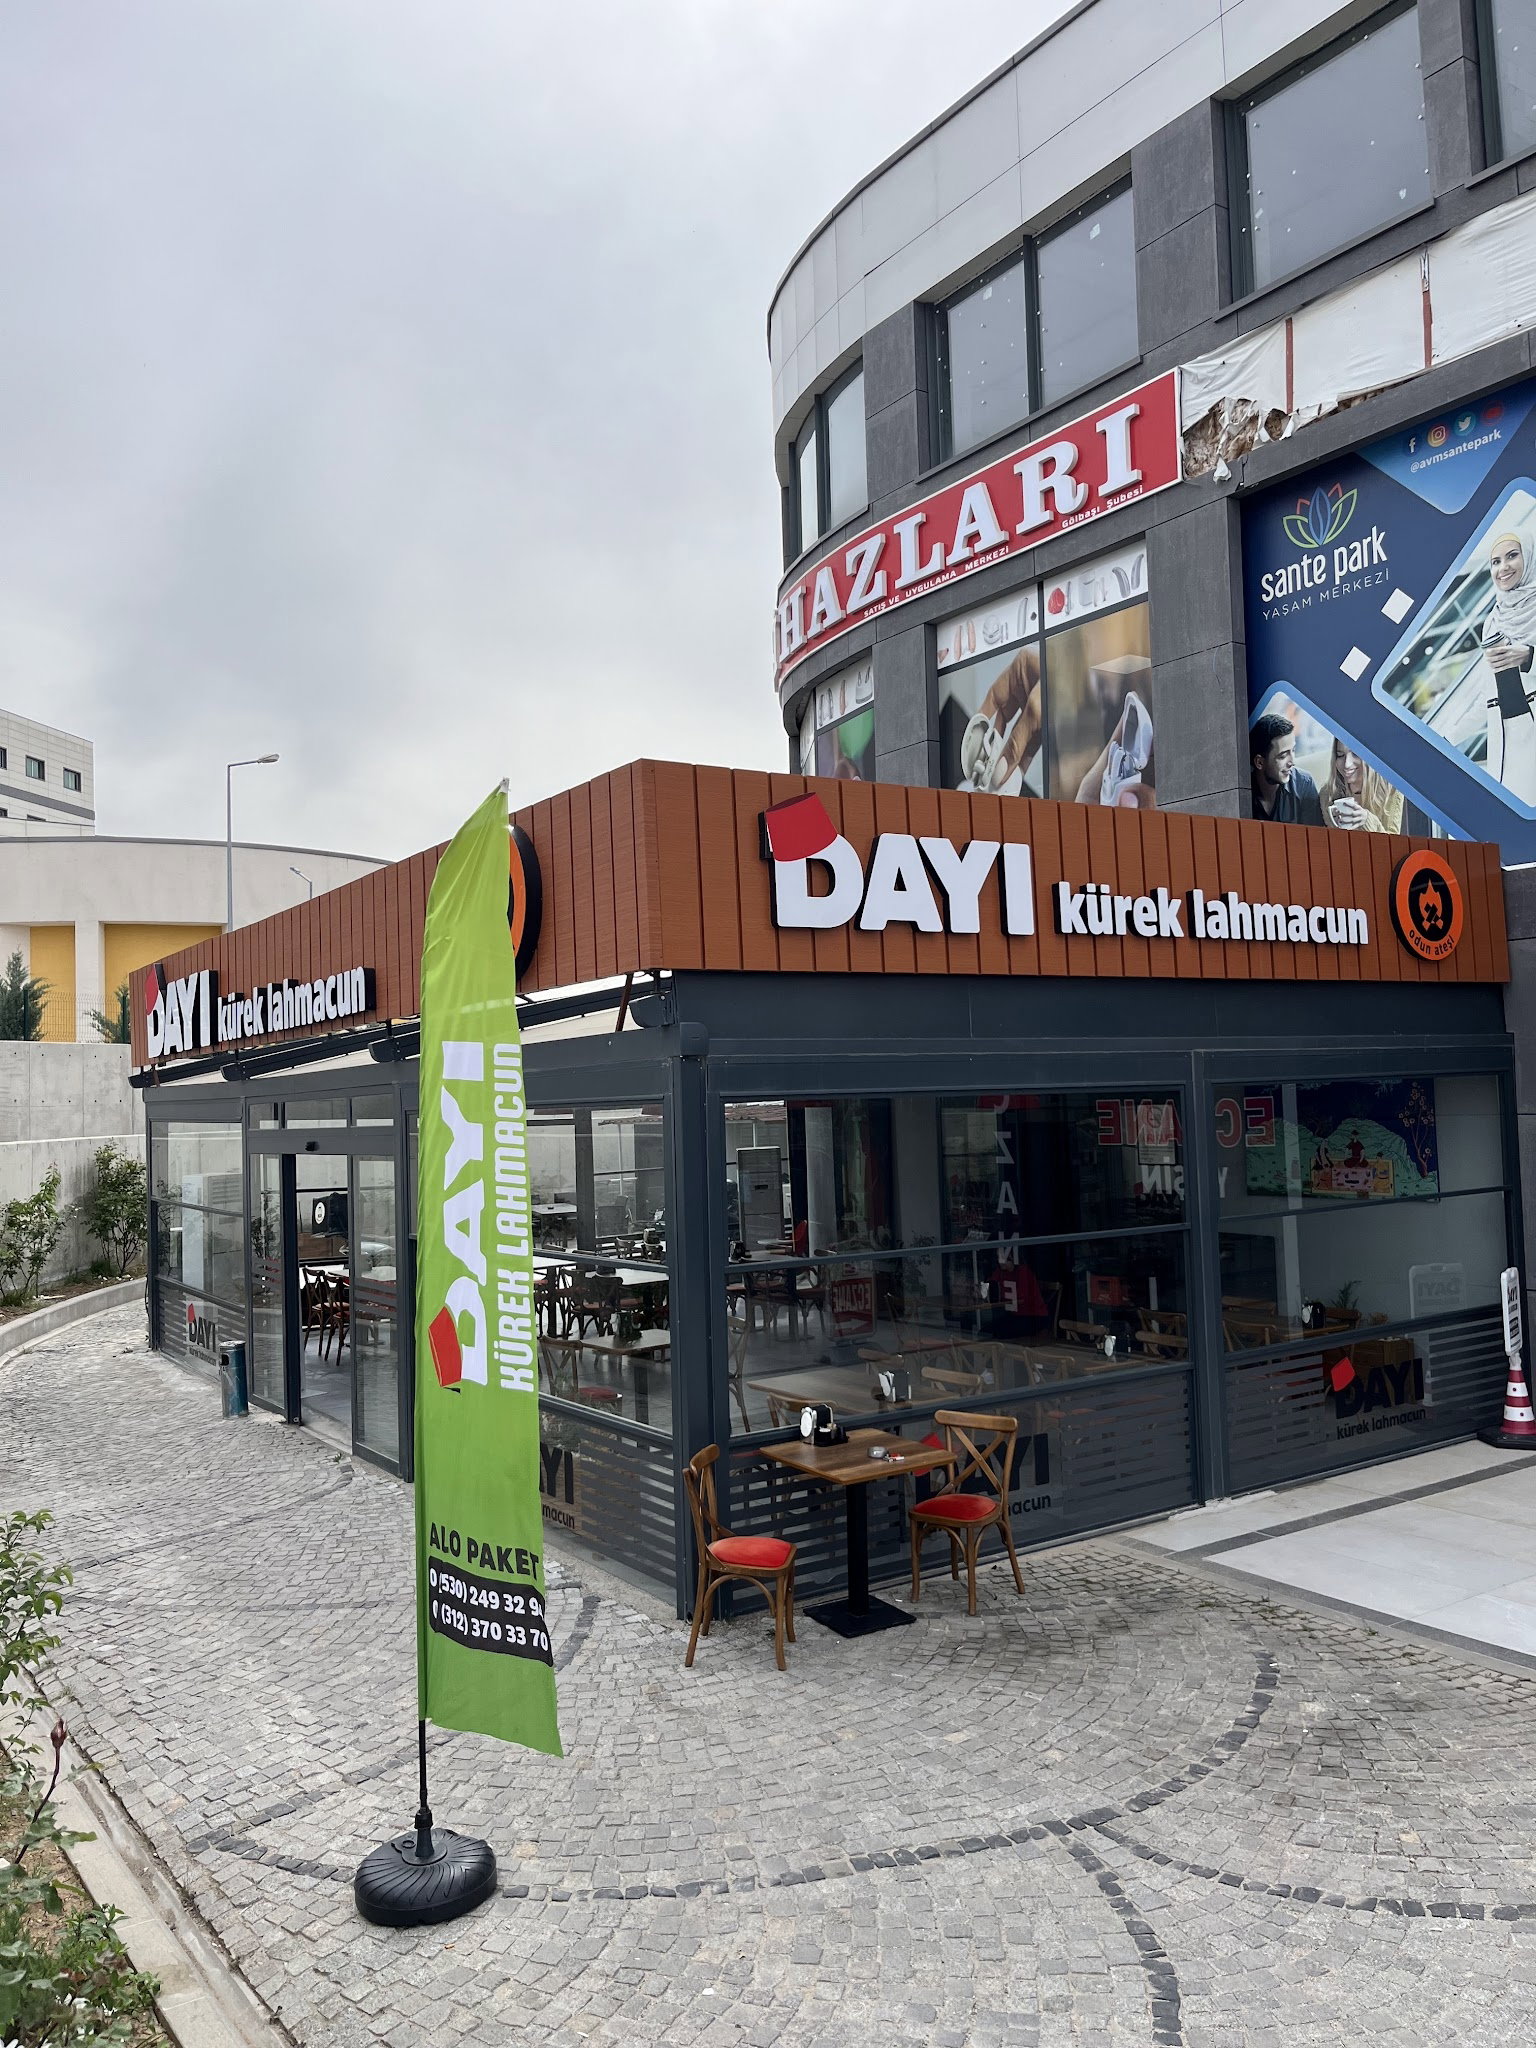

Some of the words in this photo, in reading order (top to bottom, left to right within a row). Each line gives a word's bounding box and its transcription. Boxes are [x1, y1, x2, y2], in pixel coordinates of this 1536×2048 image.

[1410, 428, 1502, 473] @avmsantepark
[1106, 485, 1143, 510] Şubesi
[774, 403, 1143, 664] HAZLARI
[1261, 554, 1327, 602] sante
[1333, 525, 1388, 585] park
[863, 601, 886, 618] SATIŞ
[889, 594, 900, 605] VE
[905, 570, 957, 598] UYGULAMA
[965, 545, 1009, 571] MERKEZİ
[1262, 596, 1312, 621] YAŞAM
[1319, 567, 1389, 602] MERKEZİ
[773, 831, 1035, 936] DAYI
[1058, 881, 1184, 938] kürek
[1193, 888, 1369, 945] lahmacun
[1409, 929, 1431, 955] odun
[147, 969, 211, 1059] DAYI
[217, 986, 264, 1042] kürek
[267, 965, 366, 1033] lahmacun
[493, 1043, 529, 1257] LAHMACUN
[440, 1040, 488, 1386] DAYI
[188, 1316, 217, 1353] DAYI
[493, 1268, 535, 1393] KÜREK
[1336, 1358, 1424, 1419] DAYI
[1336, 1420, 1370, 1440] kürek
[1372, 1408, 1426, 1432] lahmacun
[542, 1503, 575, 1530] macun
[429, 1522, 461, 1558] ALO
[467, 1536, 540, 1581] PAKET
[429, 1567, 438, 1588] 0
[438, 1571, 467, 1604] (530)
[469, 1590, 500, 1610] 249
[503, 1593, 526, 1615] 32
[441, 1602, 469, 1636] (312)
[471, 1618, 502, 1641] 370
[506, 1626, 527, 1646] 33
[530, 1628, 549, 1652] 70
